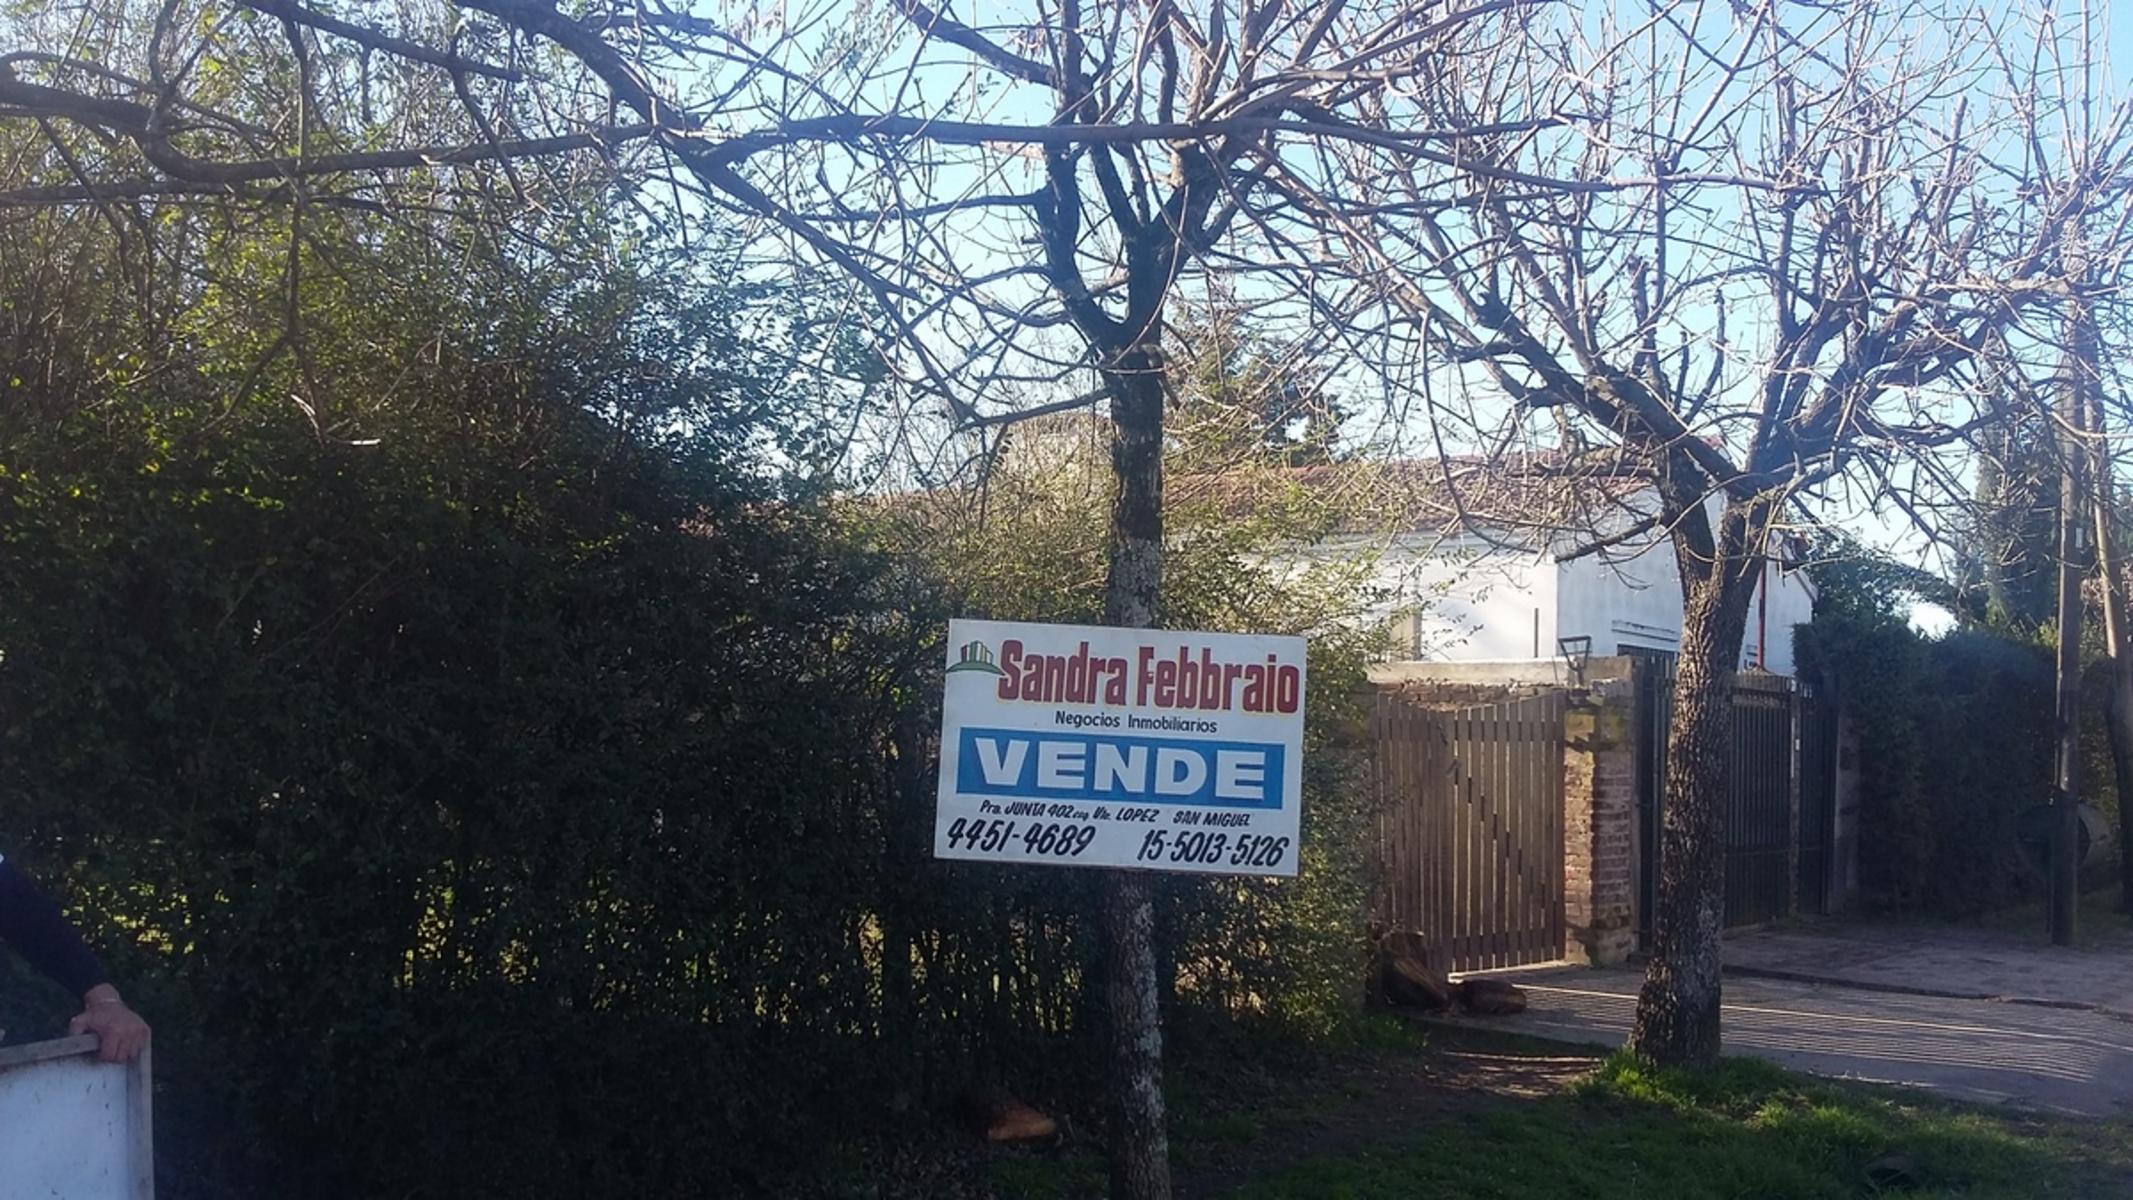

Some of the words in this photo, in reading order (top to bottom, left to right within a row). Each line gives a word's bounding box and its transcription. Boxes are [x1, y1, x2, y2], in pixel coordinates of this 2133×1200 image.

[997, 640, 1128, 706] Sandra
[1136, 646, 1300, 714] Febbraio
[1055, 711, 1120, 728] Negocios
[1128, 714, 1217, 733] Inmobiliarios
[976, 738, 1265, 799] VENDE
[1004, 801, 1046, 817] JUNTA
[1047, 804, 1074, 819] 402
[1116, 807, 1160, 823] LOPEZ
[1173, 811, 1201, 825] SAN
[1203, 813, 1250, 827] MIGUEL
[947, 817, 1096, 857] 4451-4689
[1137, 829, 1290, 867] 15-5013-5126
